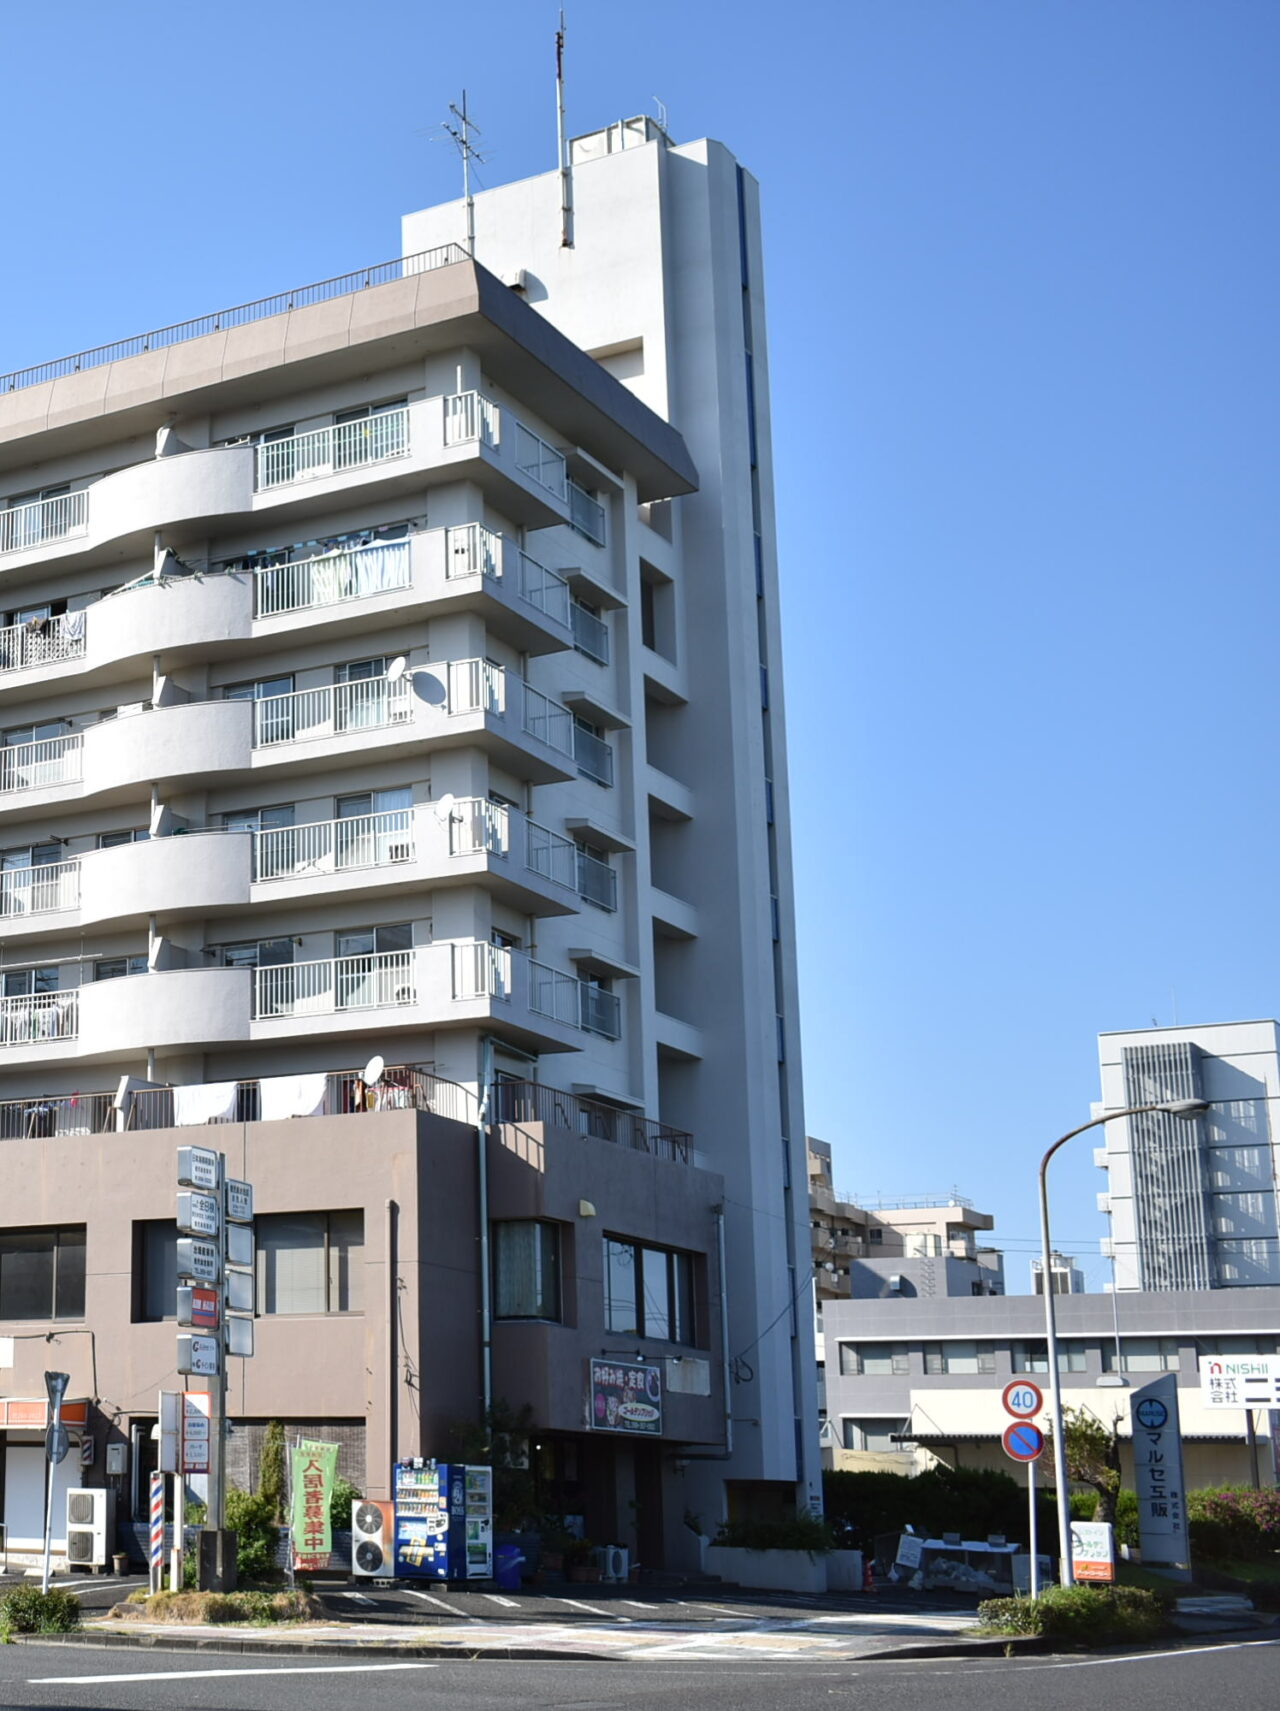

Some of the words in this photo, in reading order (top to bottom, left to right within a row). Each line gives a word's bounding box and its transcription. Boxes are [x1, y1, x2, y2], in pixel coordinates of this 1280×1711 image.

[1225, 1363, 1269, 1375] NISHII
[1011, 1391, 1034, 1409] 40
[1146, 1432, 1168, 1518] マルセ互販
[302, 1459, 325, 1551] 入居者募集中
